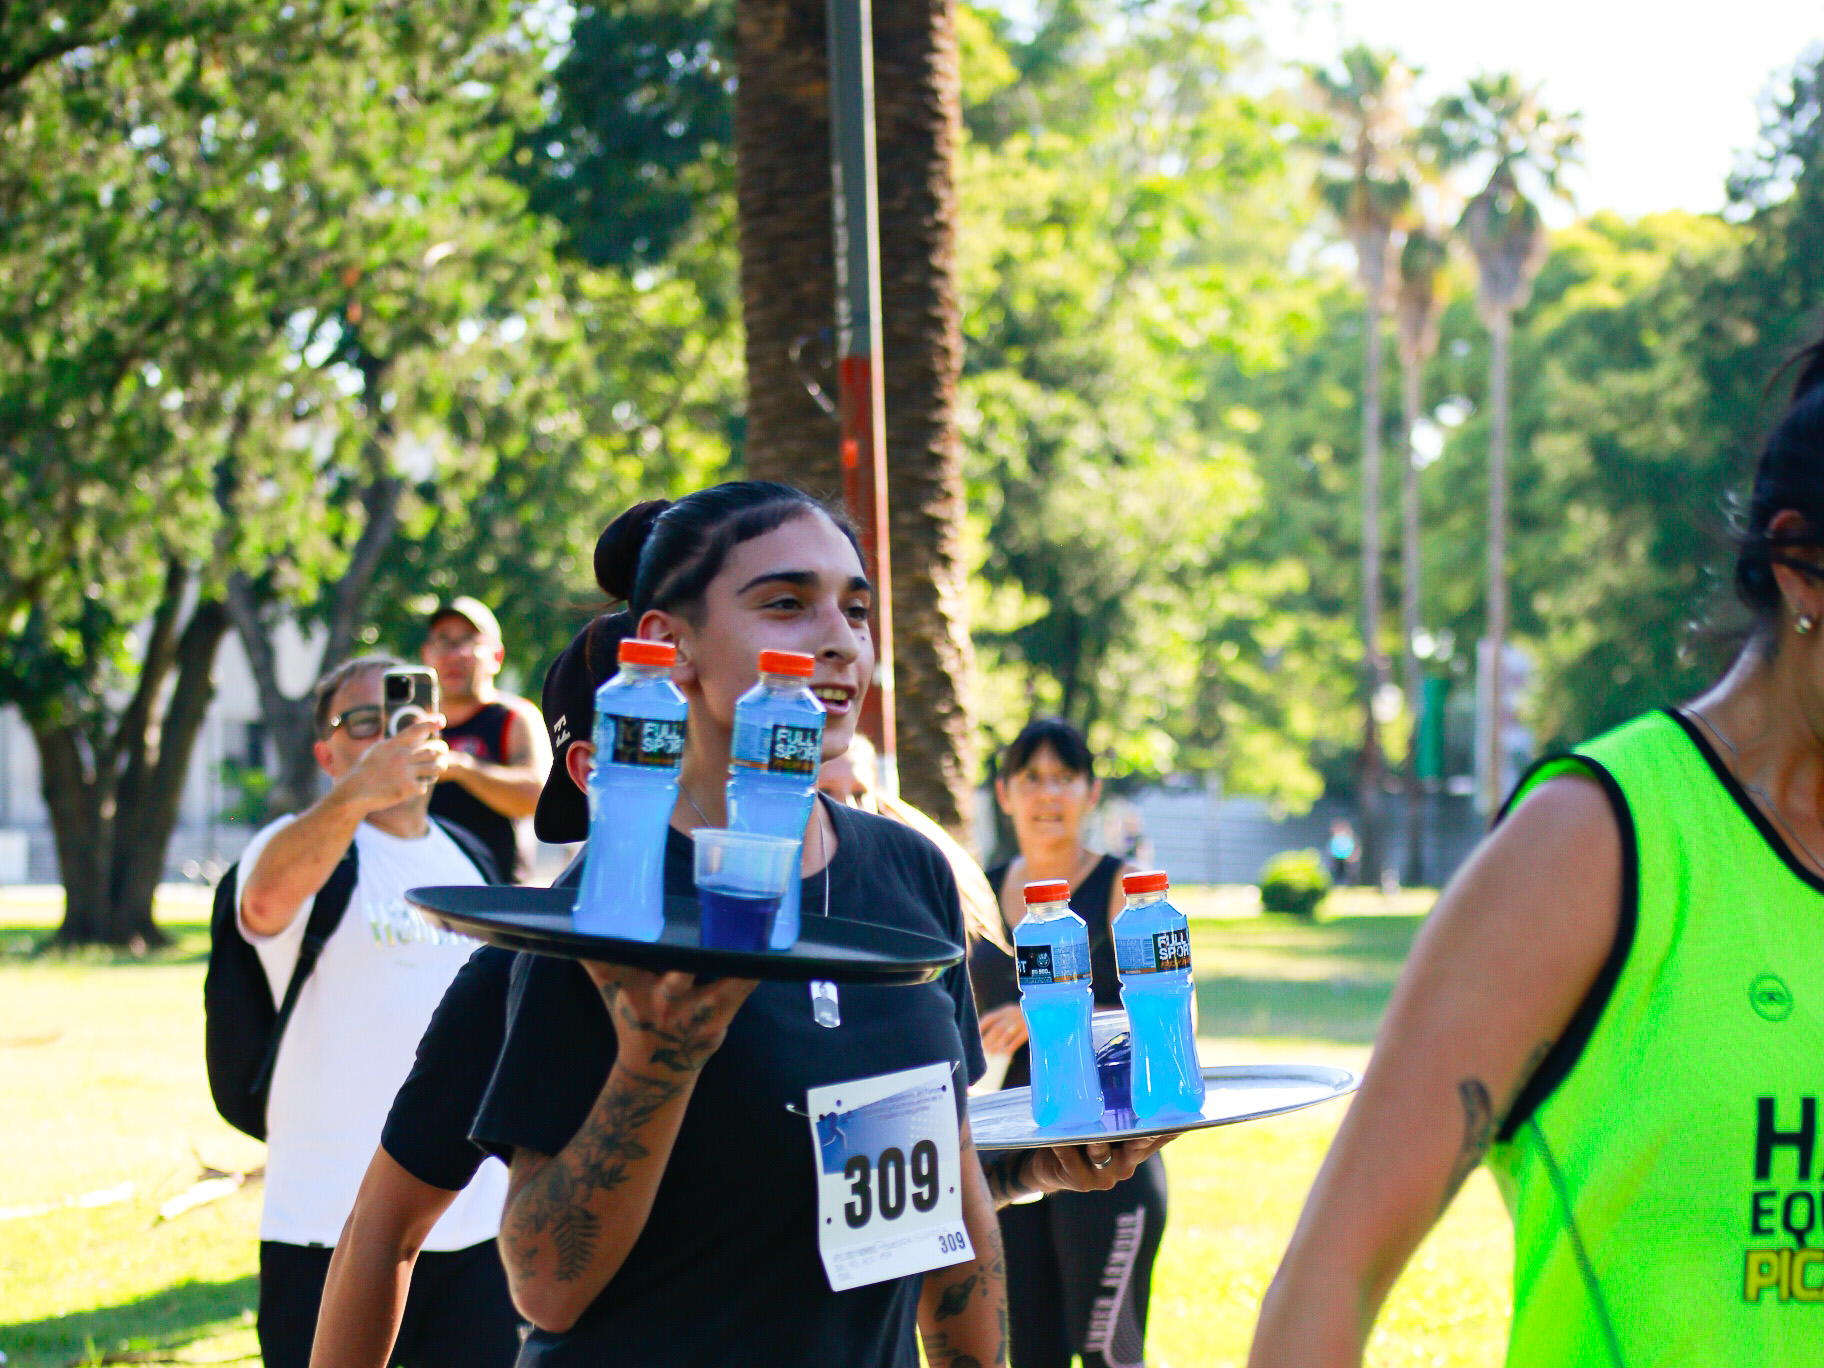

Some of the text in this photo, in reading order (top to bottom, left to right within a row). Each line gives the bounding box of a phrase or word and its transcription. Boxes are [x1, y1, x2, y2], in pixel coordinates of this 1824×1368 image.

[776, 728, 816, 748] FULL
[1157, 932, 1187, 949] FULL
[1754, 1096, 1824, 1181] H
[844, 1139, 939, 1229] 309
[1751, 1190, 1824, 1250] EQ
[937, 1231, 966, 1254] 309
